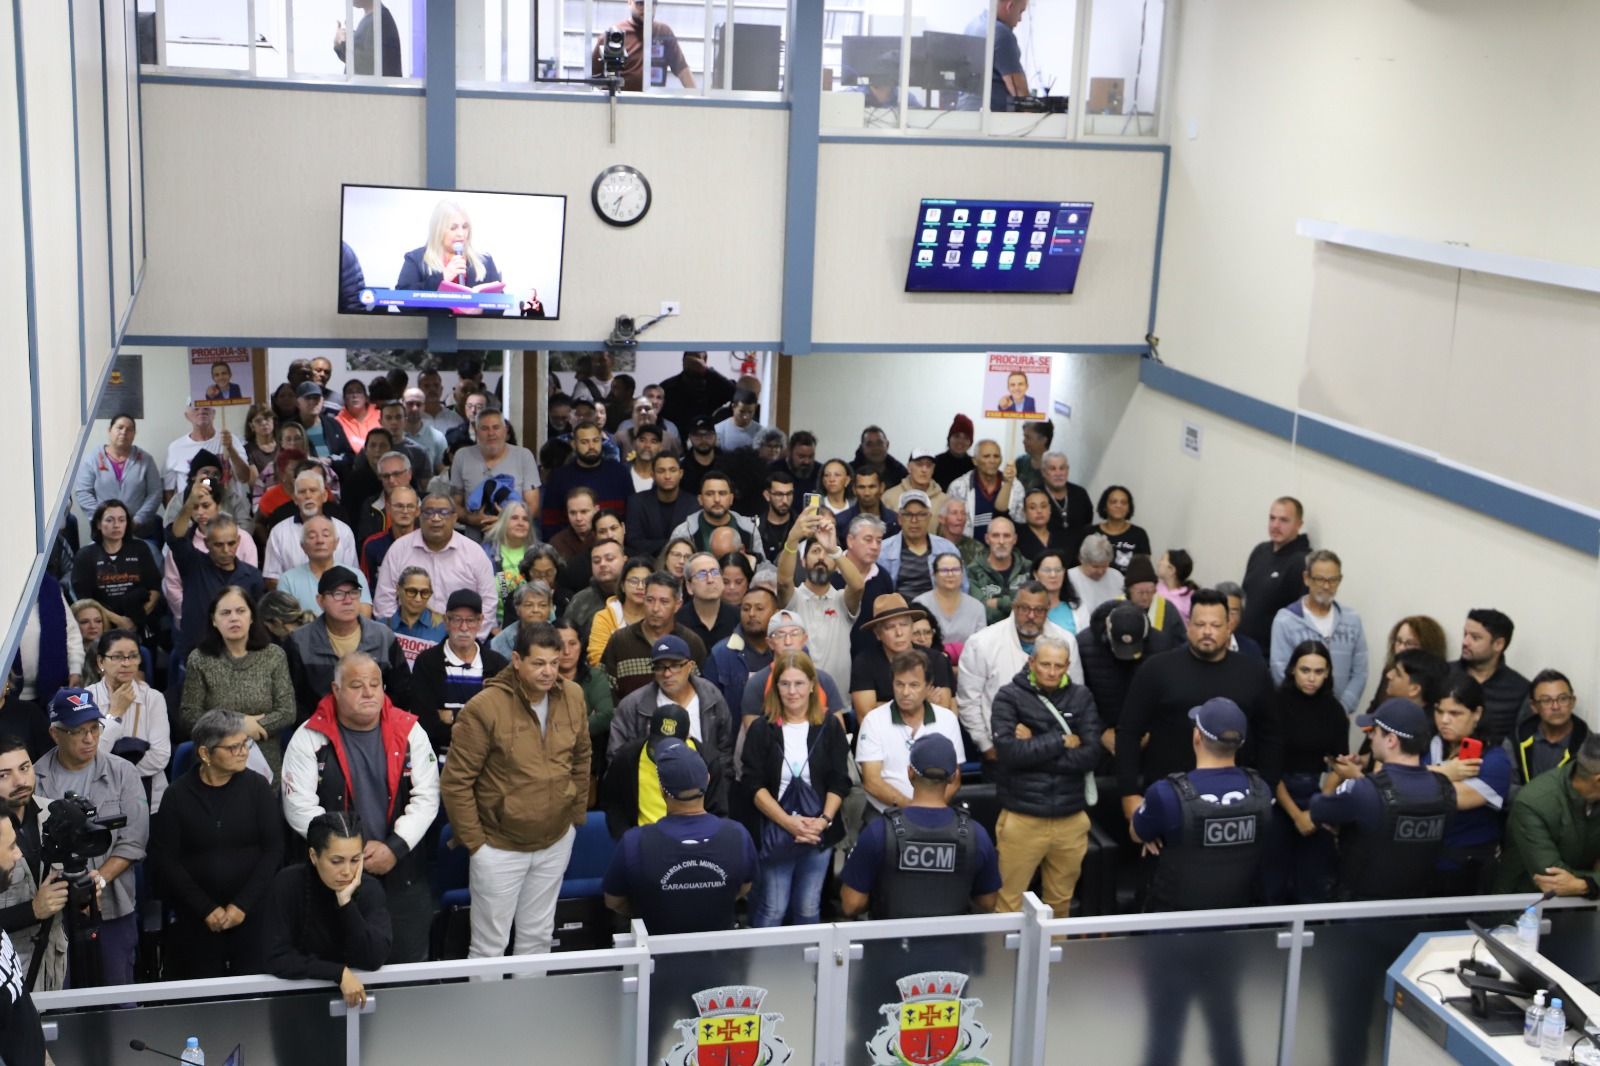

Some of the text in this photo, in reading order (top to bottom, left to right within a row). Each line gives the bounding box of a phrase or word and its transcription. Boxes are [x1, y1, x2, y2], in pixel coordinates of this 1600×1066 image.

[990, 354, 1051, 366] PROCURA-SE
[1207, 820, 1253, 843] GCM
[1399, 818, 1443, 838] GCM
[903, 845, 953, 868] GCM
[660, 859, 728, 884] GUARDA CIVIL MUNICIPAL
[661, 881, 726, 891] CARAGUATATUBA
